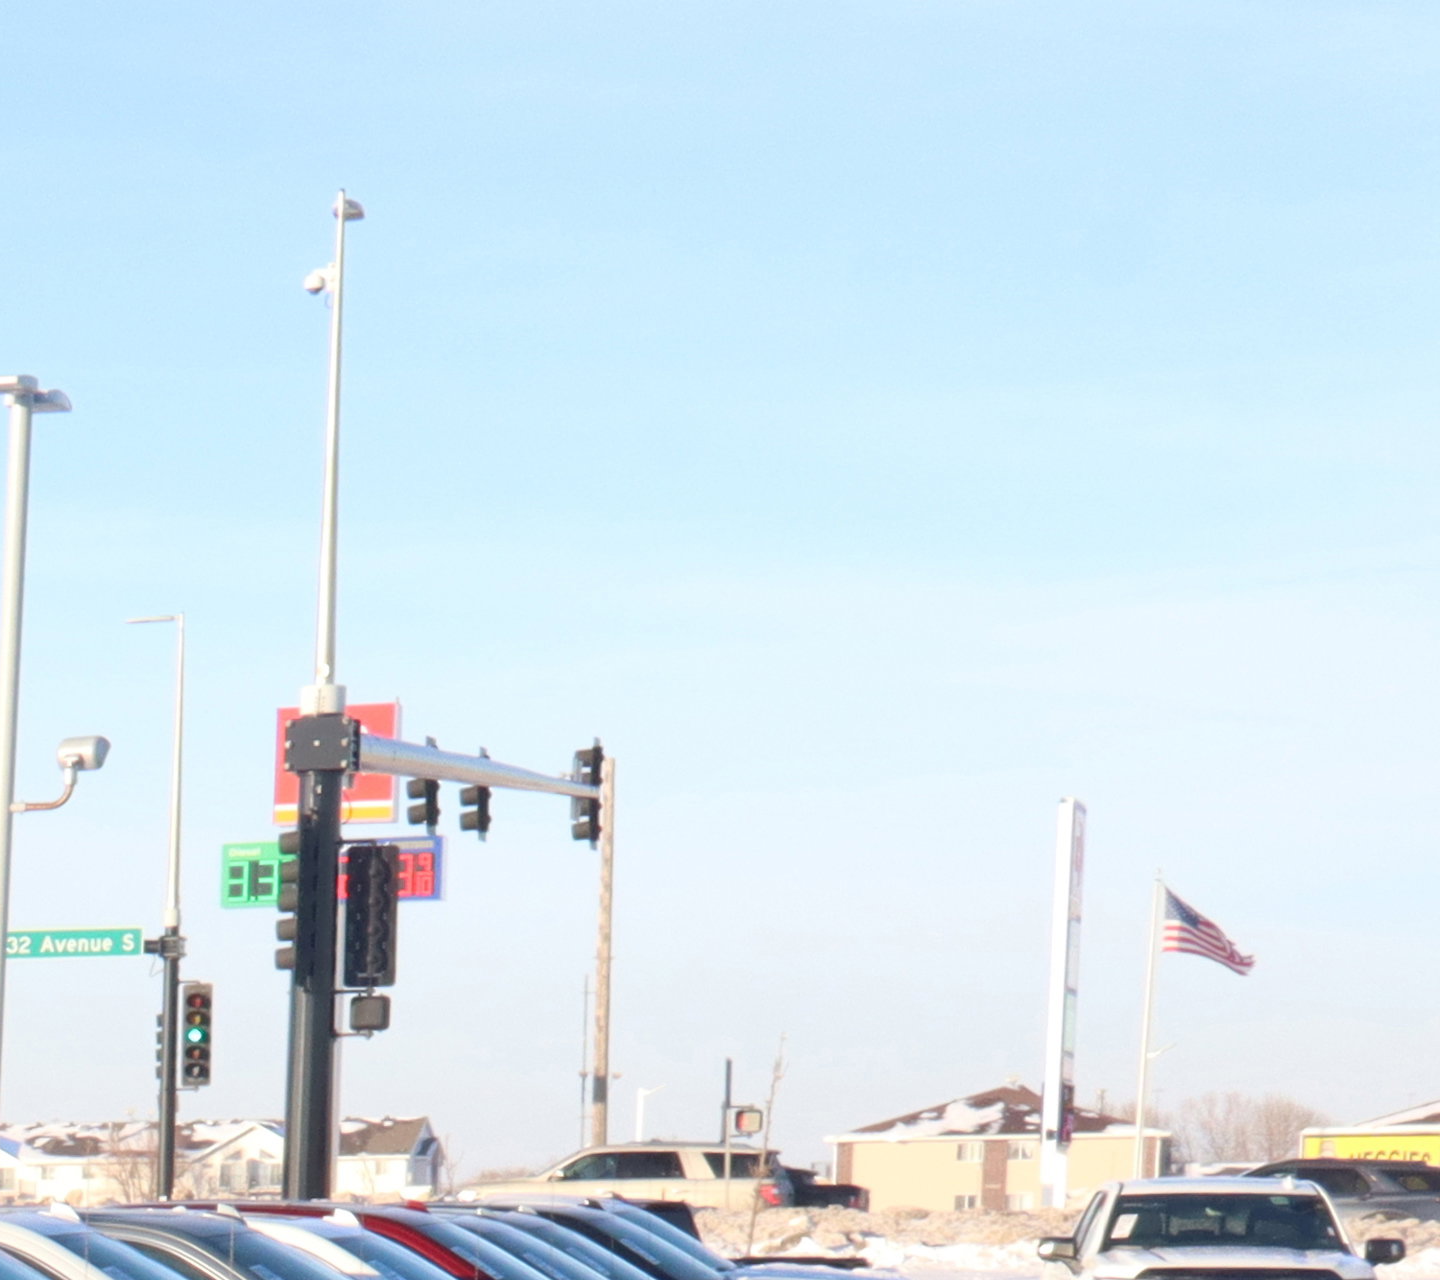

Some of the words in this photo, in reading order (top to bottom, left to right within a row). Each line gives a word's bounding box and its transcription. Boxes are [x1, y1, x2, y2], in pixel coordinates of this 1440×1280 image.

[6, 936, 31, 954] 32
[40, 935, 113, 954] Avenue
[121, 933, 135, 951] S
